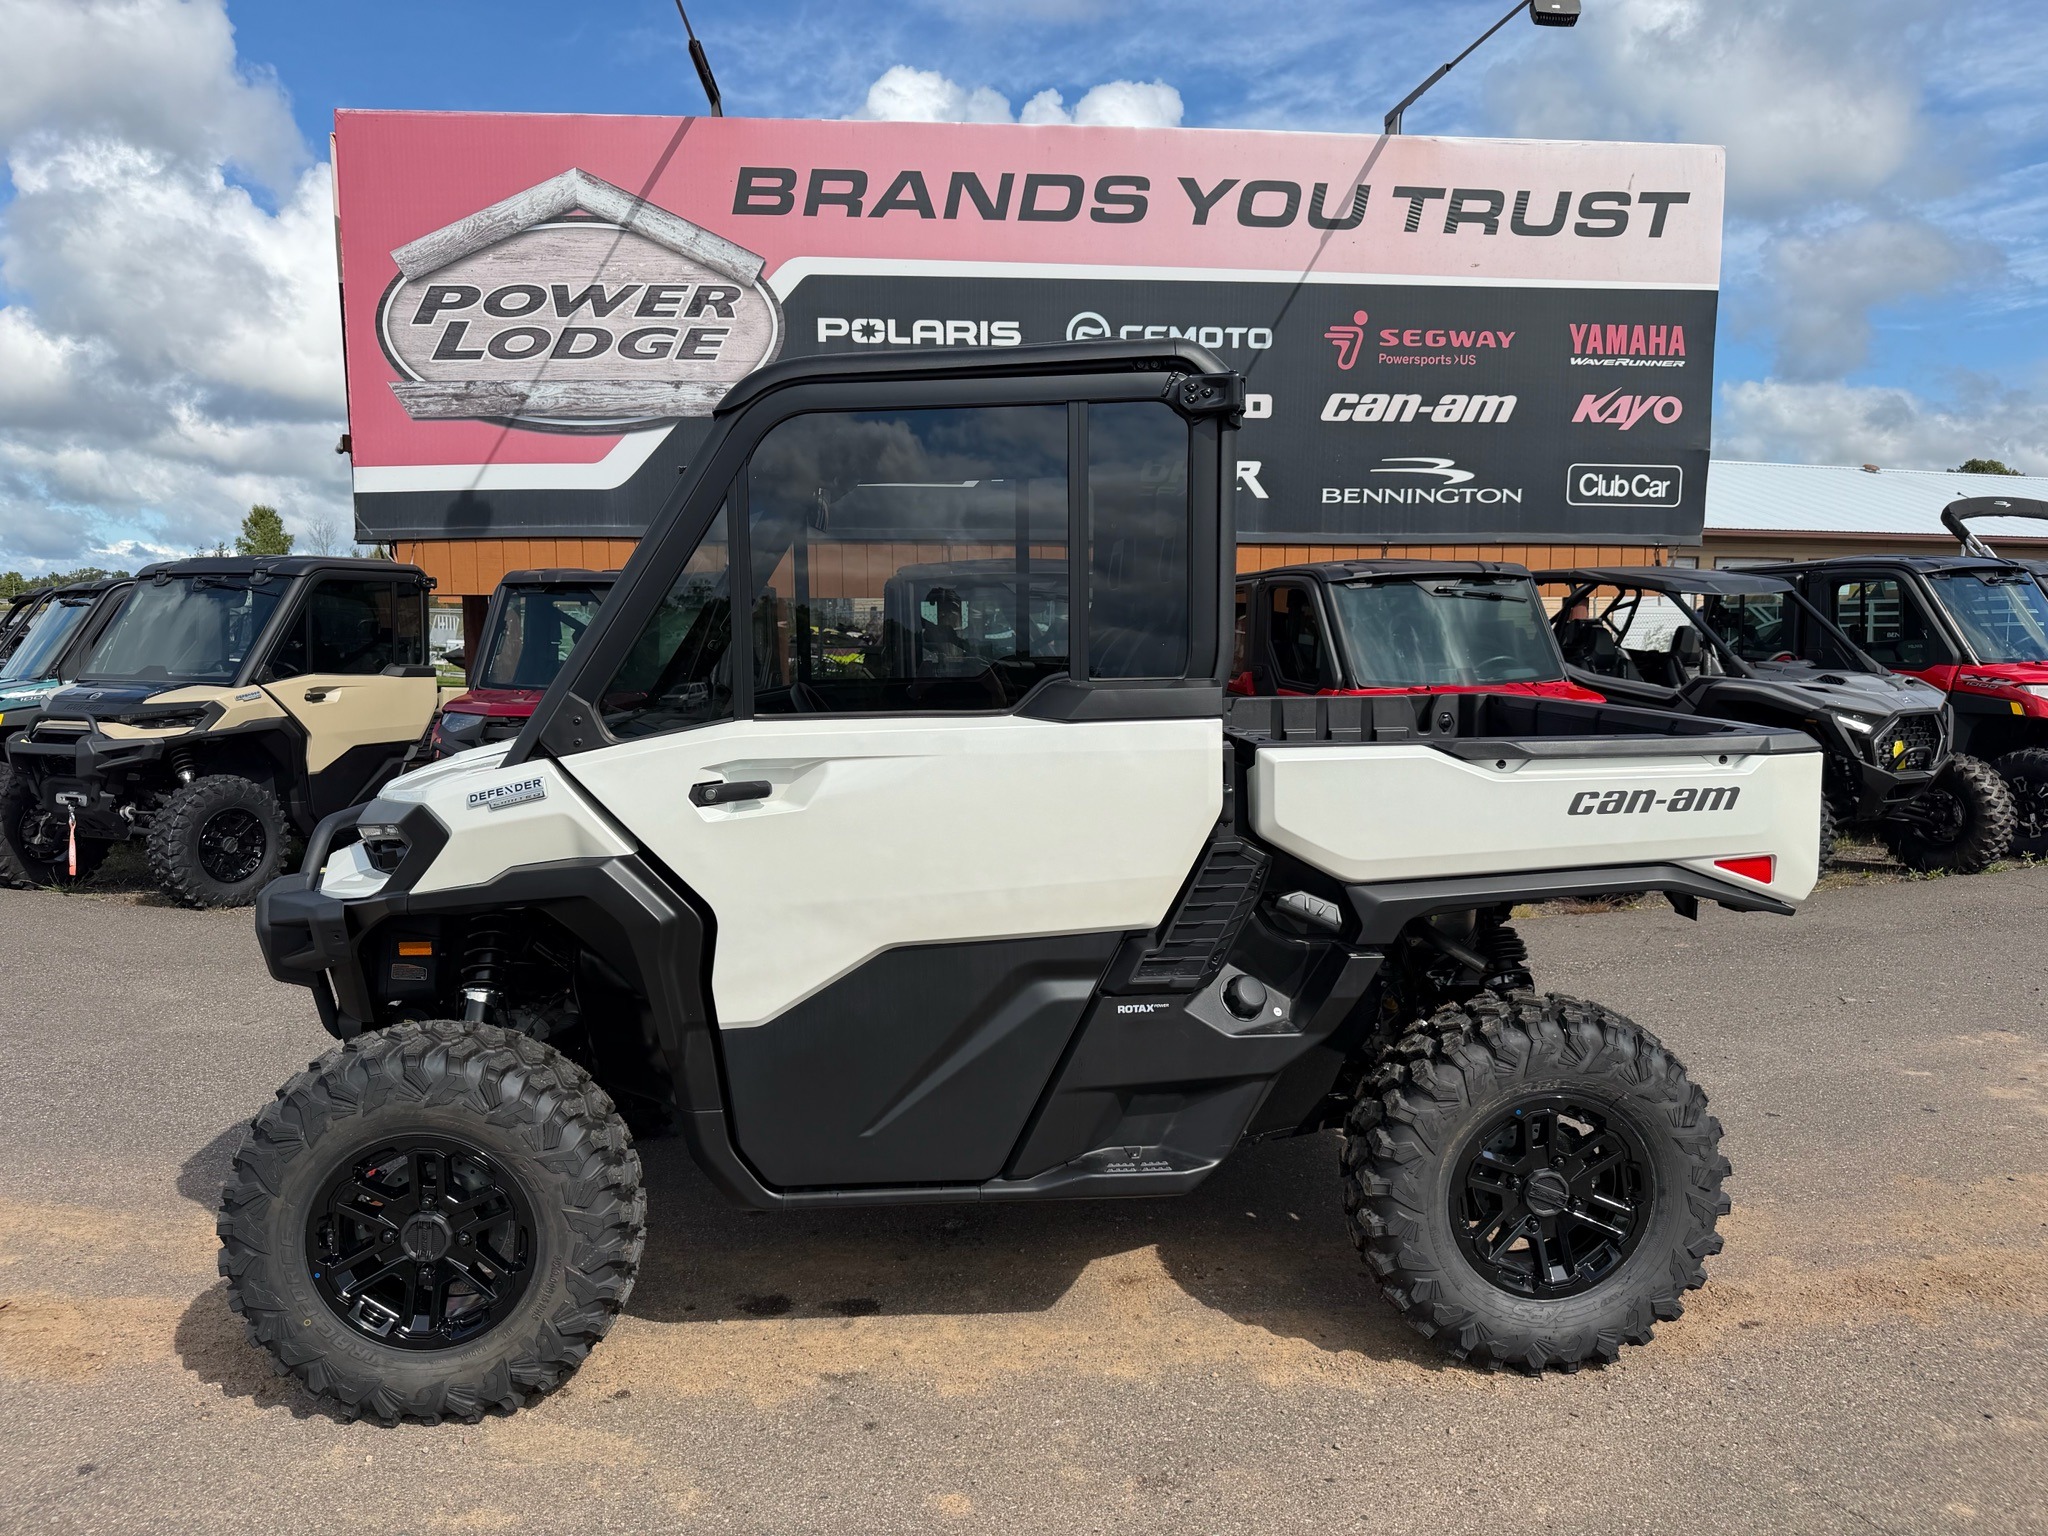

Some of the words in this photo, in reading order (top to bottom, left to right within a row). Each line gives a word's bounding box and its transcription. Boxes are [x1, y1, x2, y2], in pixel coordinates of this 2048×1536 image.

[731, 166, 1151, 224] BRANDS
[1176, 176, 1372, 231] YOU
[1392, 186, 1691, 239] TRUST
[411, 284, 743, 326] POWER
[430, 321, 731, 362] LODGE
[817, 317, 1022, 346] POLARIS
[1379, 329, 1516, 348] SEGWAY
[1569, 323, 1686, 357] YAMAHA
[1378, 353, 1452, 367] Powersports
[1320, 393, 1518, 423] can-am
[1571, 386, 1683, 431] KAYO
[1321, 488, 1523, 505] BENNINGTON
[1578, 473, 1629, 498] Club
[1631, 475, 1671, 499] Car
[1966, 681, 1999, 690] 1000
[469, 779, 541, 803] DEFENDER
[1567, 786, 1741, 816] can-am
[1117, 1003, 1155, 1014] ROTAX
